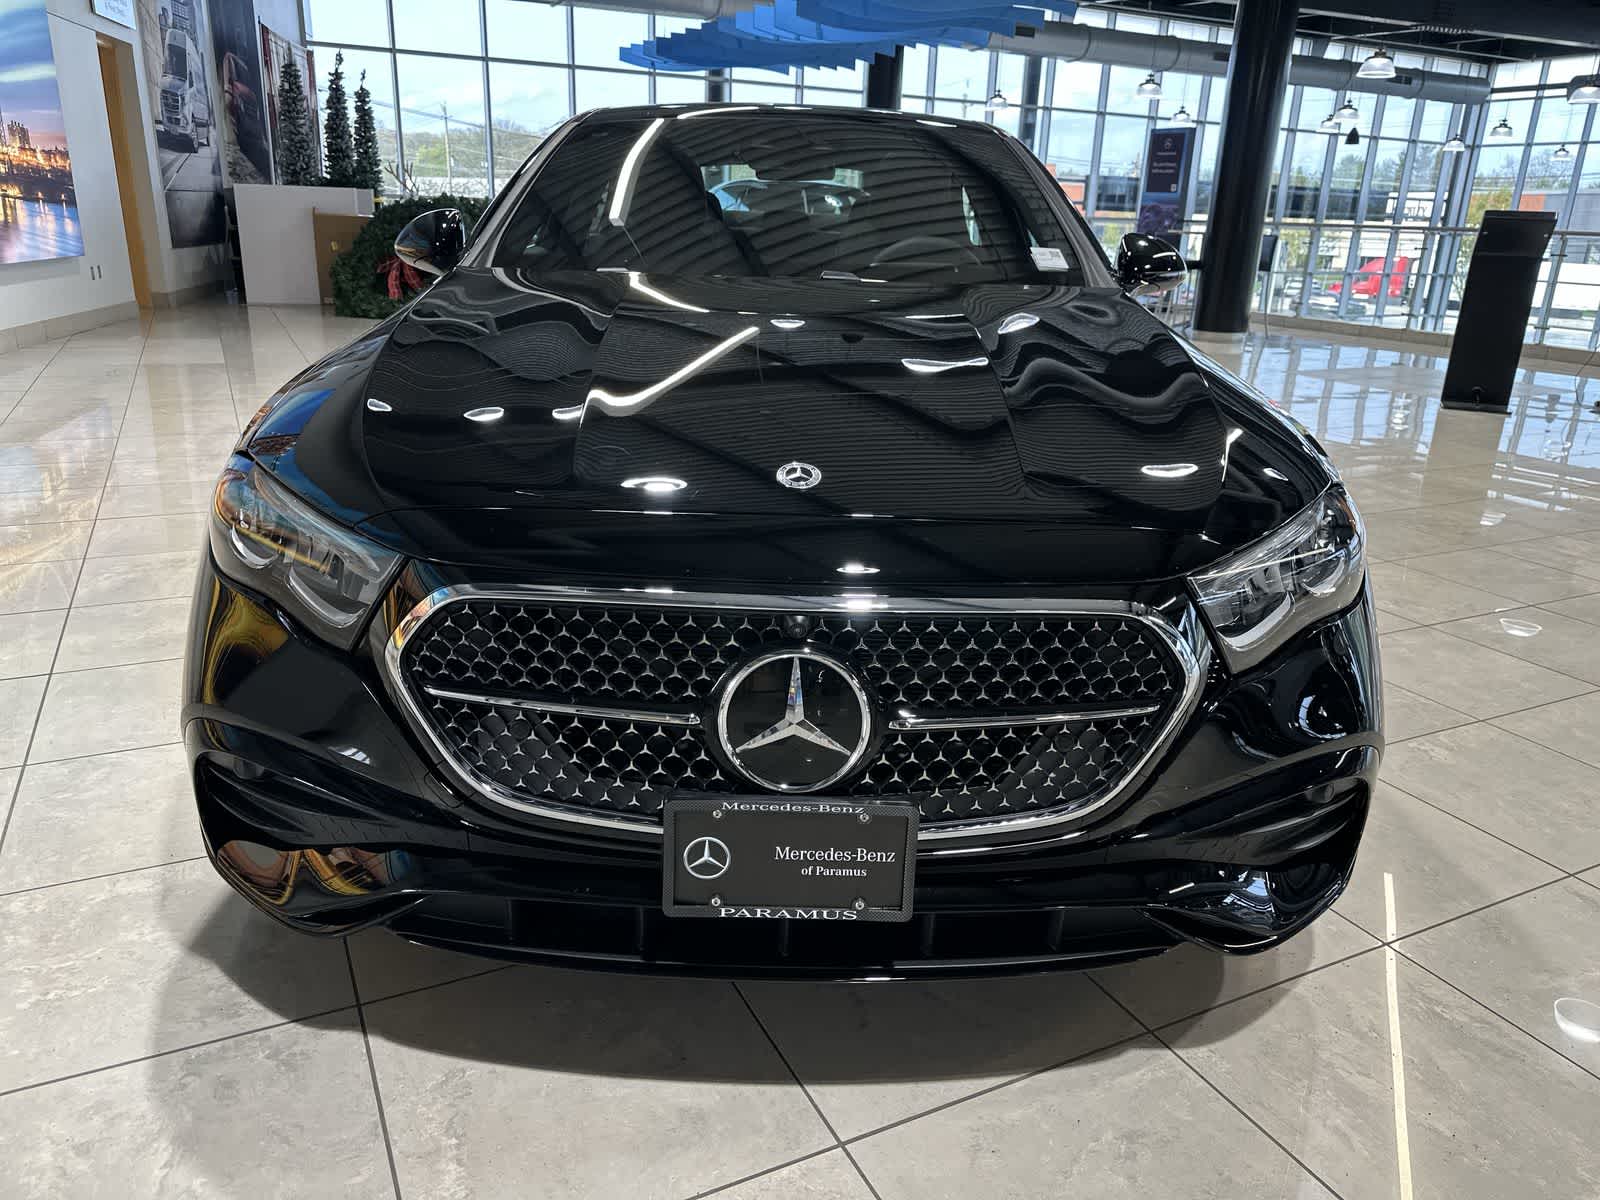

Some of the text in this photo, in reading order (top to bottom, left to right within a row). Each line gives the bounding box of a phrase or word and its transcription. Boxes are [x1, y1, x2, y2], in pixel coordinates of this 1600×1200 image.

[721, 801, 865, 814] Mercedes-Benz
[775, 846, 896, 863] Mercedes-Benz
[801, 865, 867, 877] of Paramus
[719, 907, 858, 920] PARAMUS
